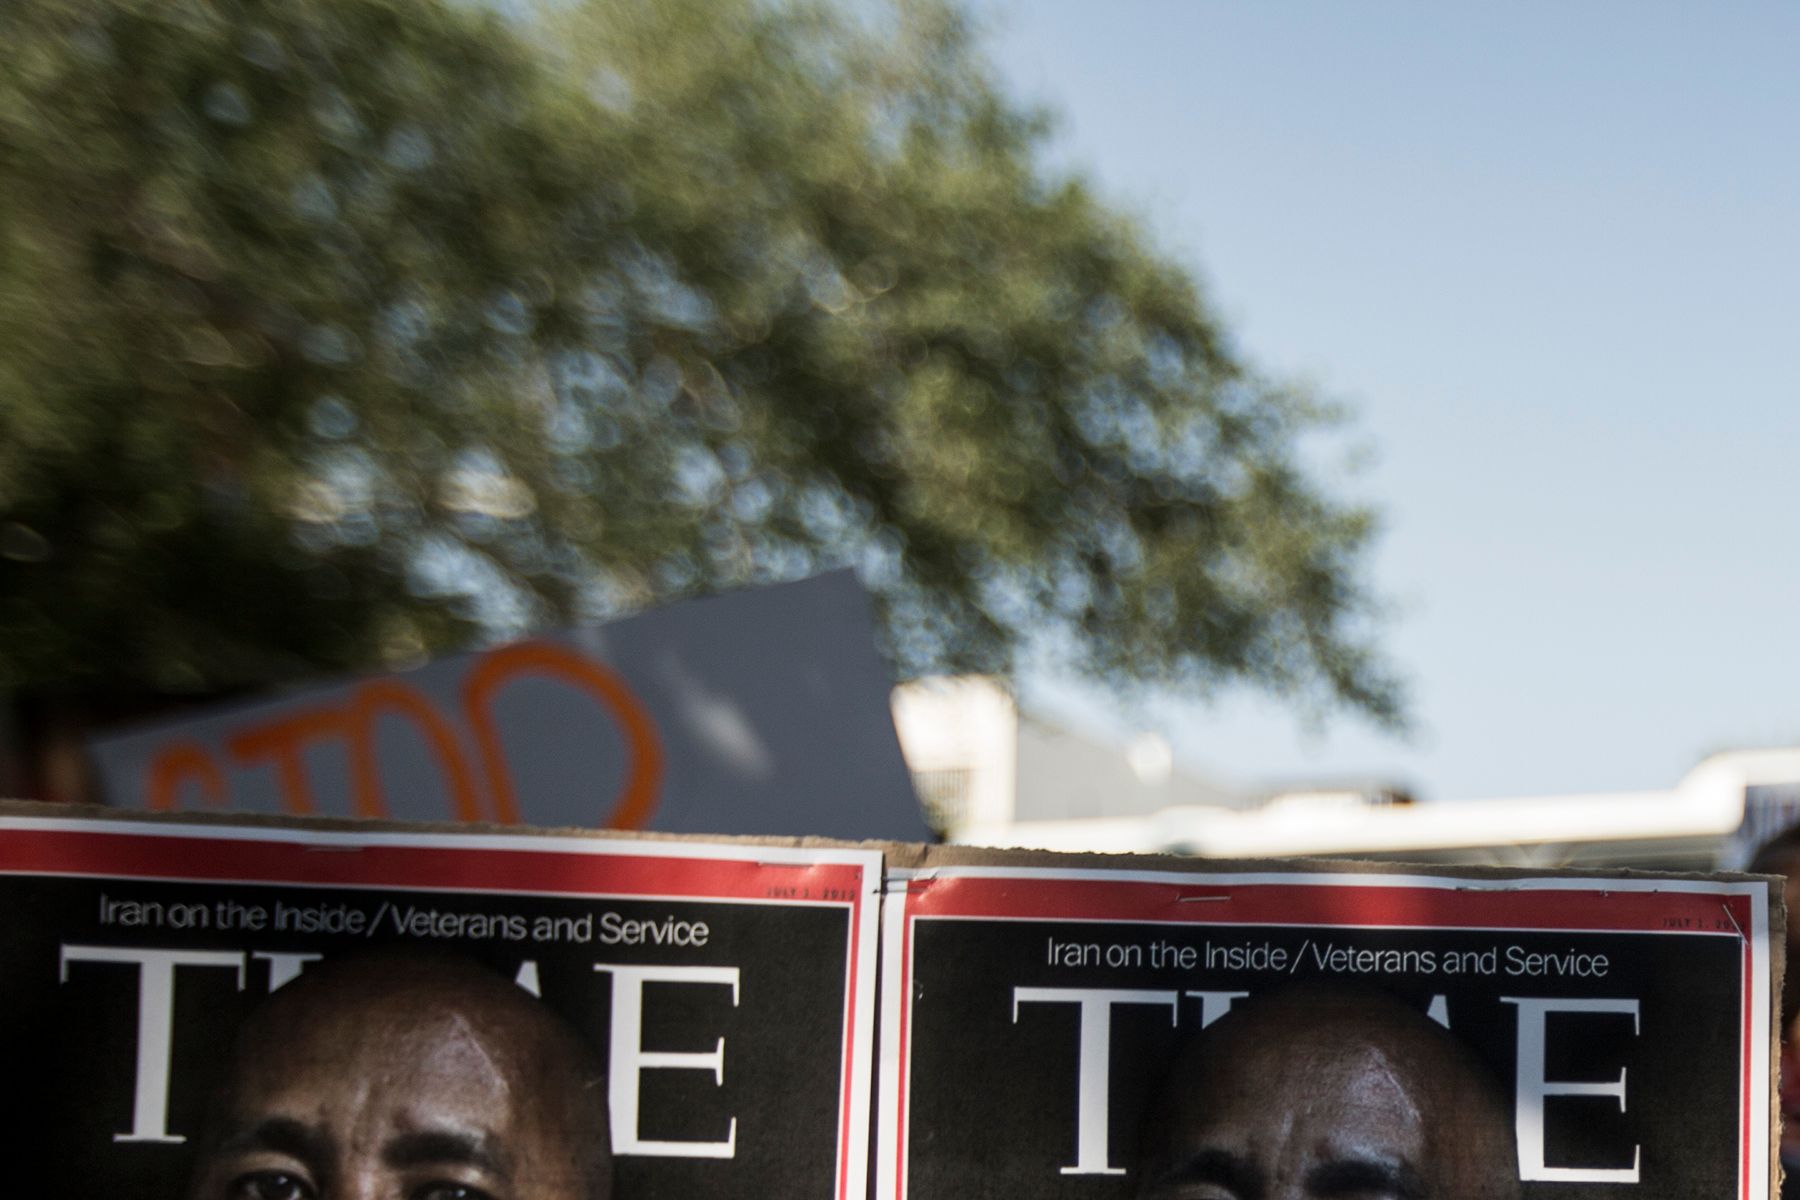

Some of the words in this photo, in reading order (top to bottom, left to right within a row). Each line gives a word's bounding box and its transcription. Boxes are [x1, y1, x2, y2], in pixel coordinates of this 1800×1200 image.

[101, 893, 164, 926] Iran
[168, 904, 209, 929] on
[215, 900, 268, 930] the
[532, 914, 592, 943] and
[600, 912, 709, 947] Service
[1048, 937, 1101, 967] Iran
[1106, 944, 1142, 968] on
[1150, 940, 1197, 970] the
[1442, 946, 1497, 975] and
[1504, 946, 1609, 977] Service
[60, 944, 740, 1159] TE
[1013, 987, 1641, 1183] TE
